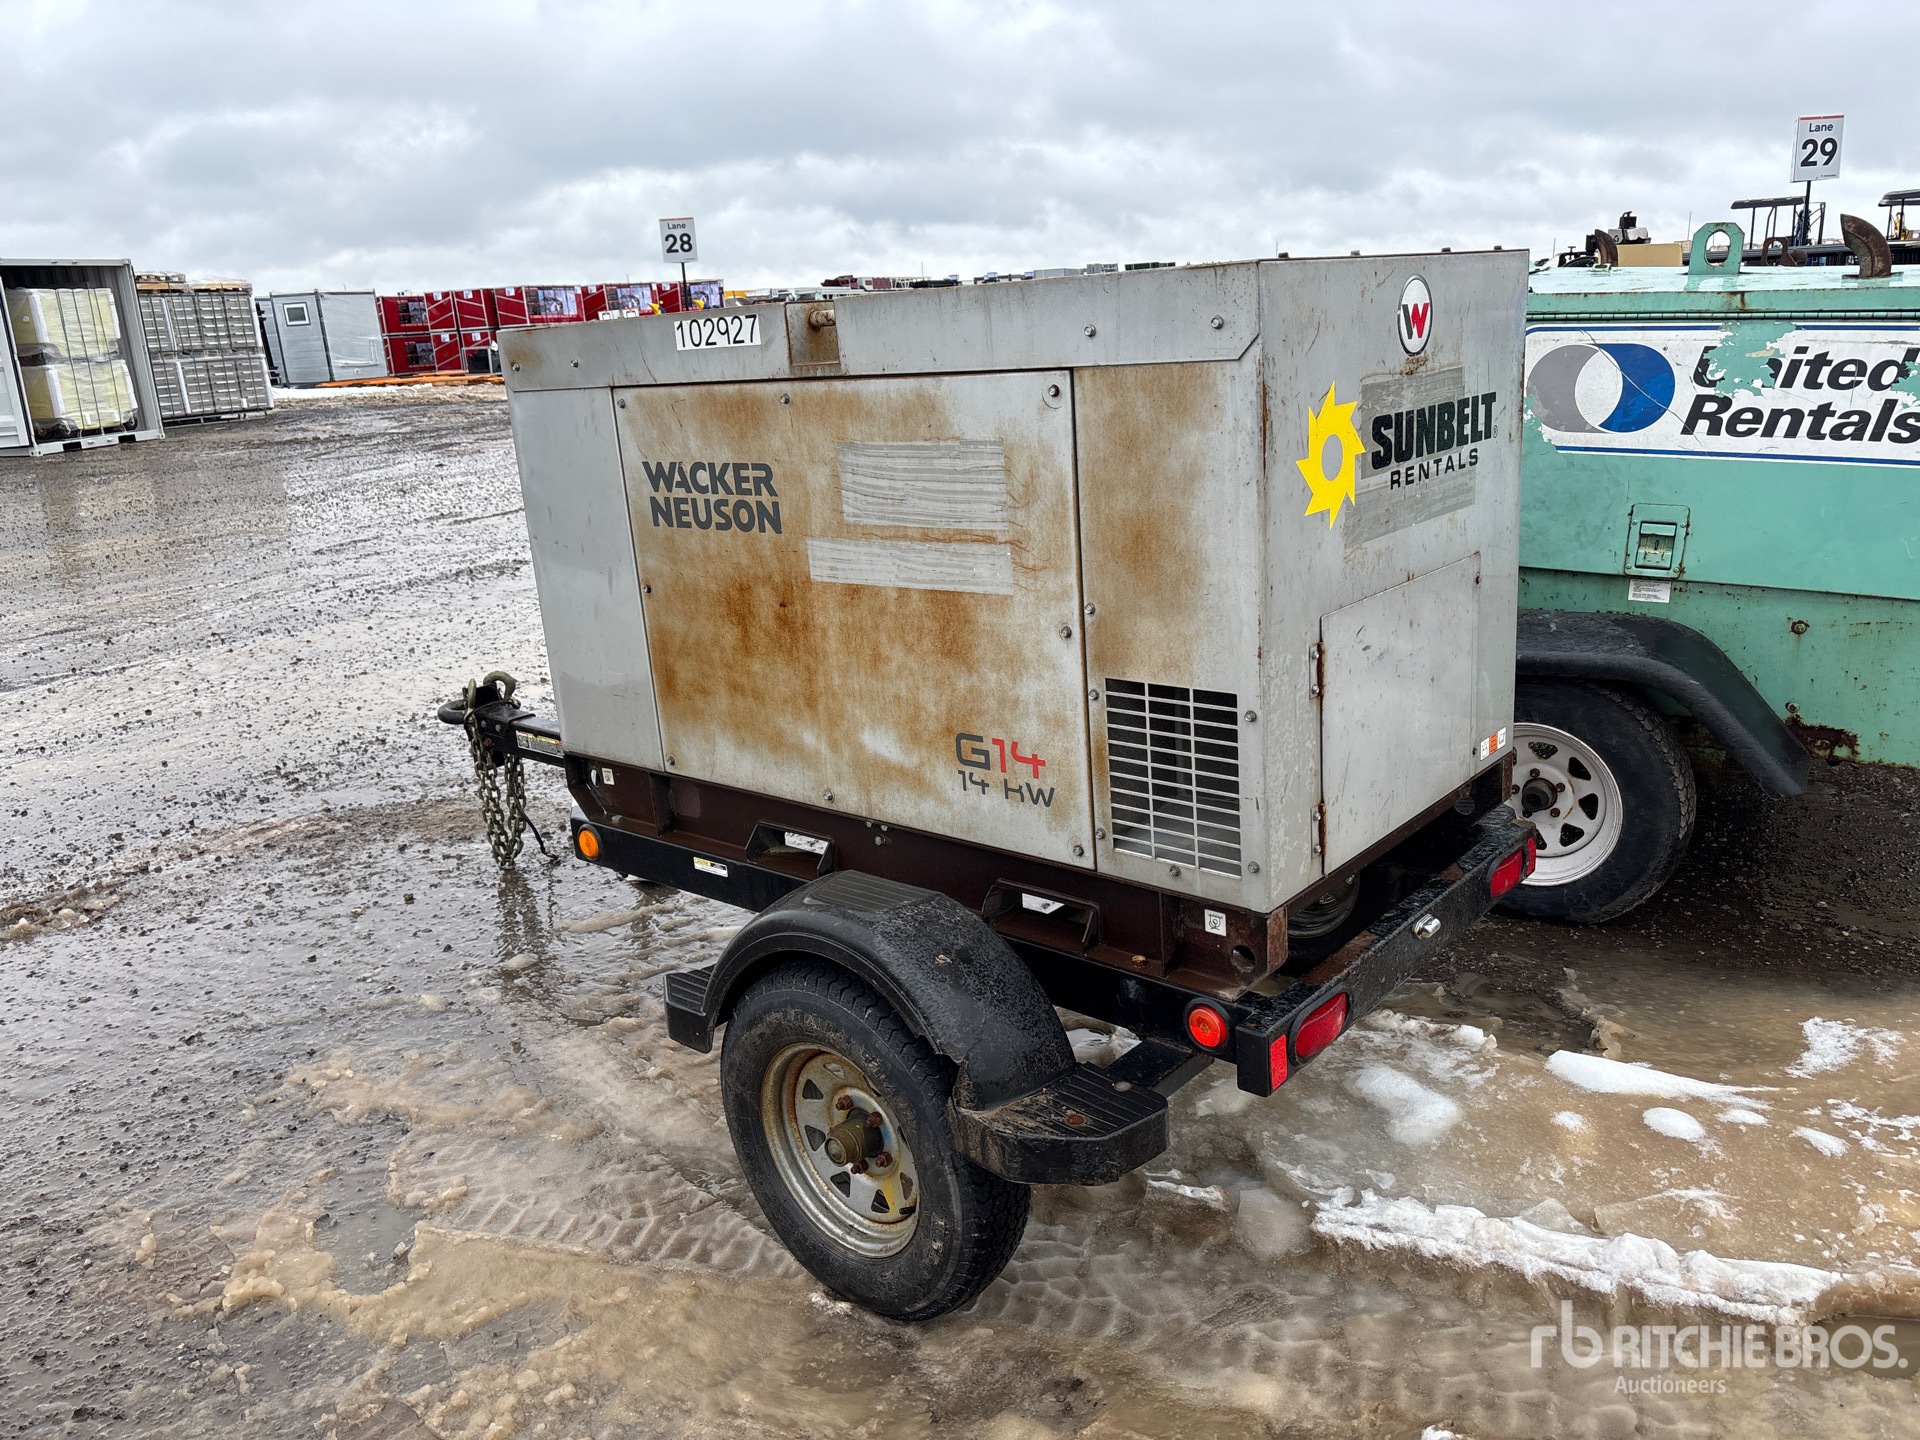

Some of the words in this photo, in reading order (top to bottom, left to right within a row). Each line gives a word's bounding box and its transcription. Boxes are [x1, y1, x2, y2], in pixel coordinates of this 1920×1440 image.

[1808, 123, 1834, 133] Lane
[1800, 137, 1838, 167] 29
[664, 233, 693, 254] 28
[667, 222, 686, 230] Lane
[676, 314, 757, 348] 102927
[1401, 302, 1430, 340] W
[1693, 345, 1920, 391] ited
[1371, 391, 1497, 470] SUNBELT
[1680, 393, 1920, 444] Rentals
[642, 461, 779, 497] WACKER
[1390, 448, 1479, 490] RENTALS
[649, 496, 783, 535] NEUSON
[955, 732, 1046, 779] G14
[957, 769, 989, 795] 14
